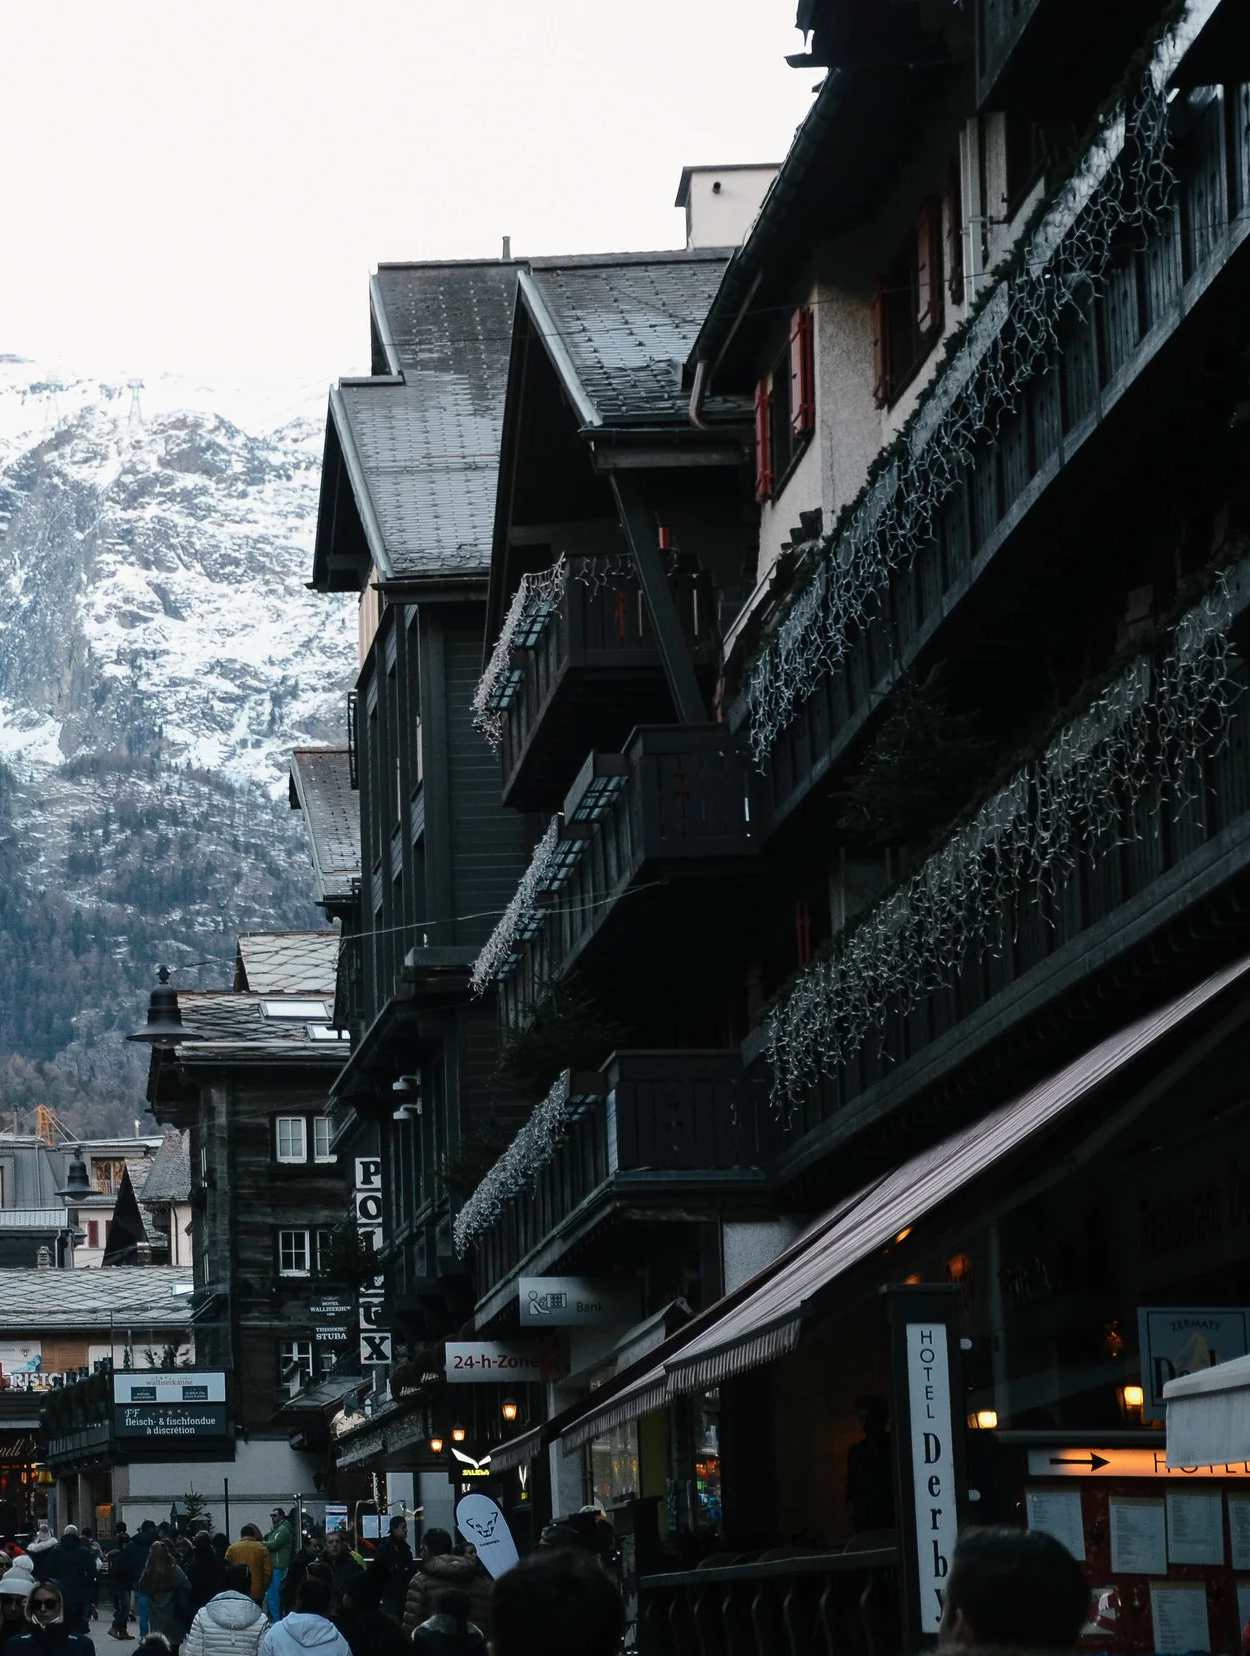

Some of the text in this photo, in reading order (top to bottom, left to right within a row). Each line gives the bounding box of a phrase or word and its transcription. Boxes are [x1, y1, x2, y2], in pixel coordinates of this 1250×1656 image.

[576, 1301, 605, 1312] Bank
[1169, 1318, 1222, 1333] ZERMATT
[315, 1332, 348, 1340] STUBA
[453, 1354, 540, 1369] 24-h-Zone
[920, 1330, 935, 1419] HOTEL
[125, 1416, 216, 1426] fleisch- & fischfondue
[153, 1426, 196, 1434] discrétion
[922, 1432, 949, 1622] Derby
